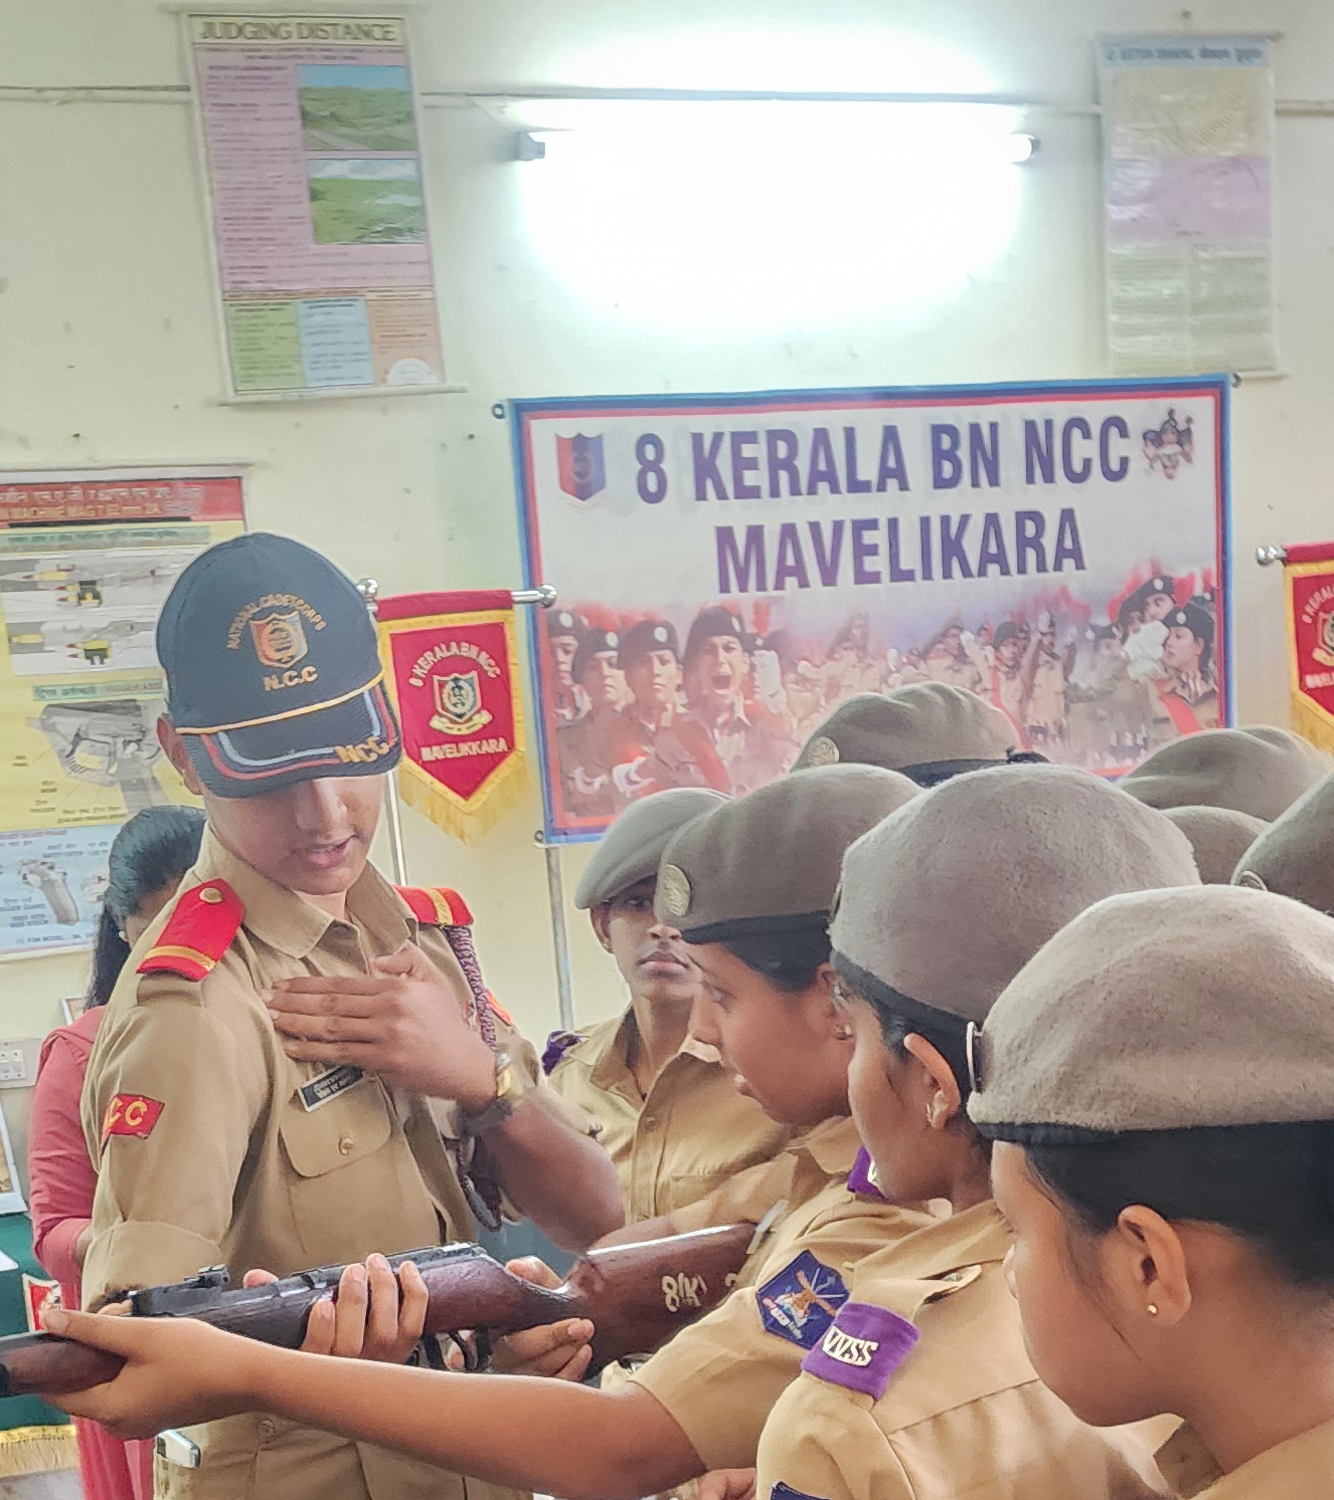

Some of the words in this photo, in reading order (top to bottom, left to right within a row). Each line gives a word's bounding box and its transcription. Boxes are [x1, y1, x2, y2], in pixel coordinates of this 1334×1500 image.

[202, 21, 293, 39] JUDGING
[296, 23, 397, 41] DISTANCE
[635, 432, 666, 504] 8
[691, 424, 910, 502] KERALA
[929, 421, 1001, 490] BN
[1024, 415, 1131, 484] NCC
[714, 507, 1087, 595] MAVELIKARA
[411, 641, 460, 679] KERALA
[334, 735, 392, 763] NCC
[108, 1097, 148, 1127] CC
[822, 1324, 879, 1367] VVSS
